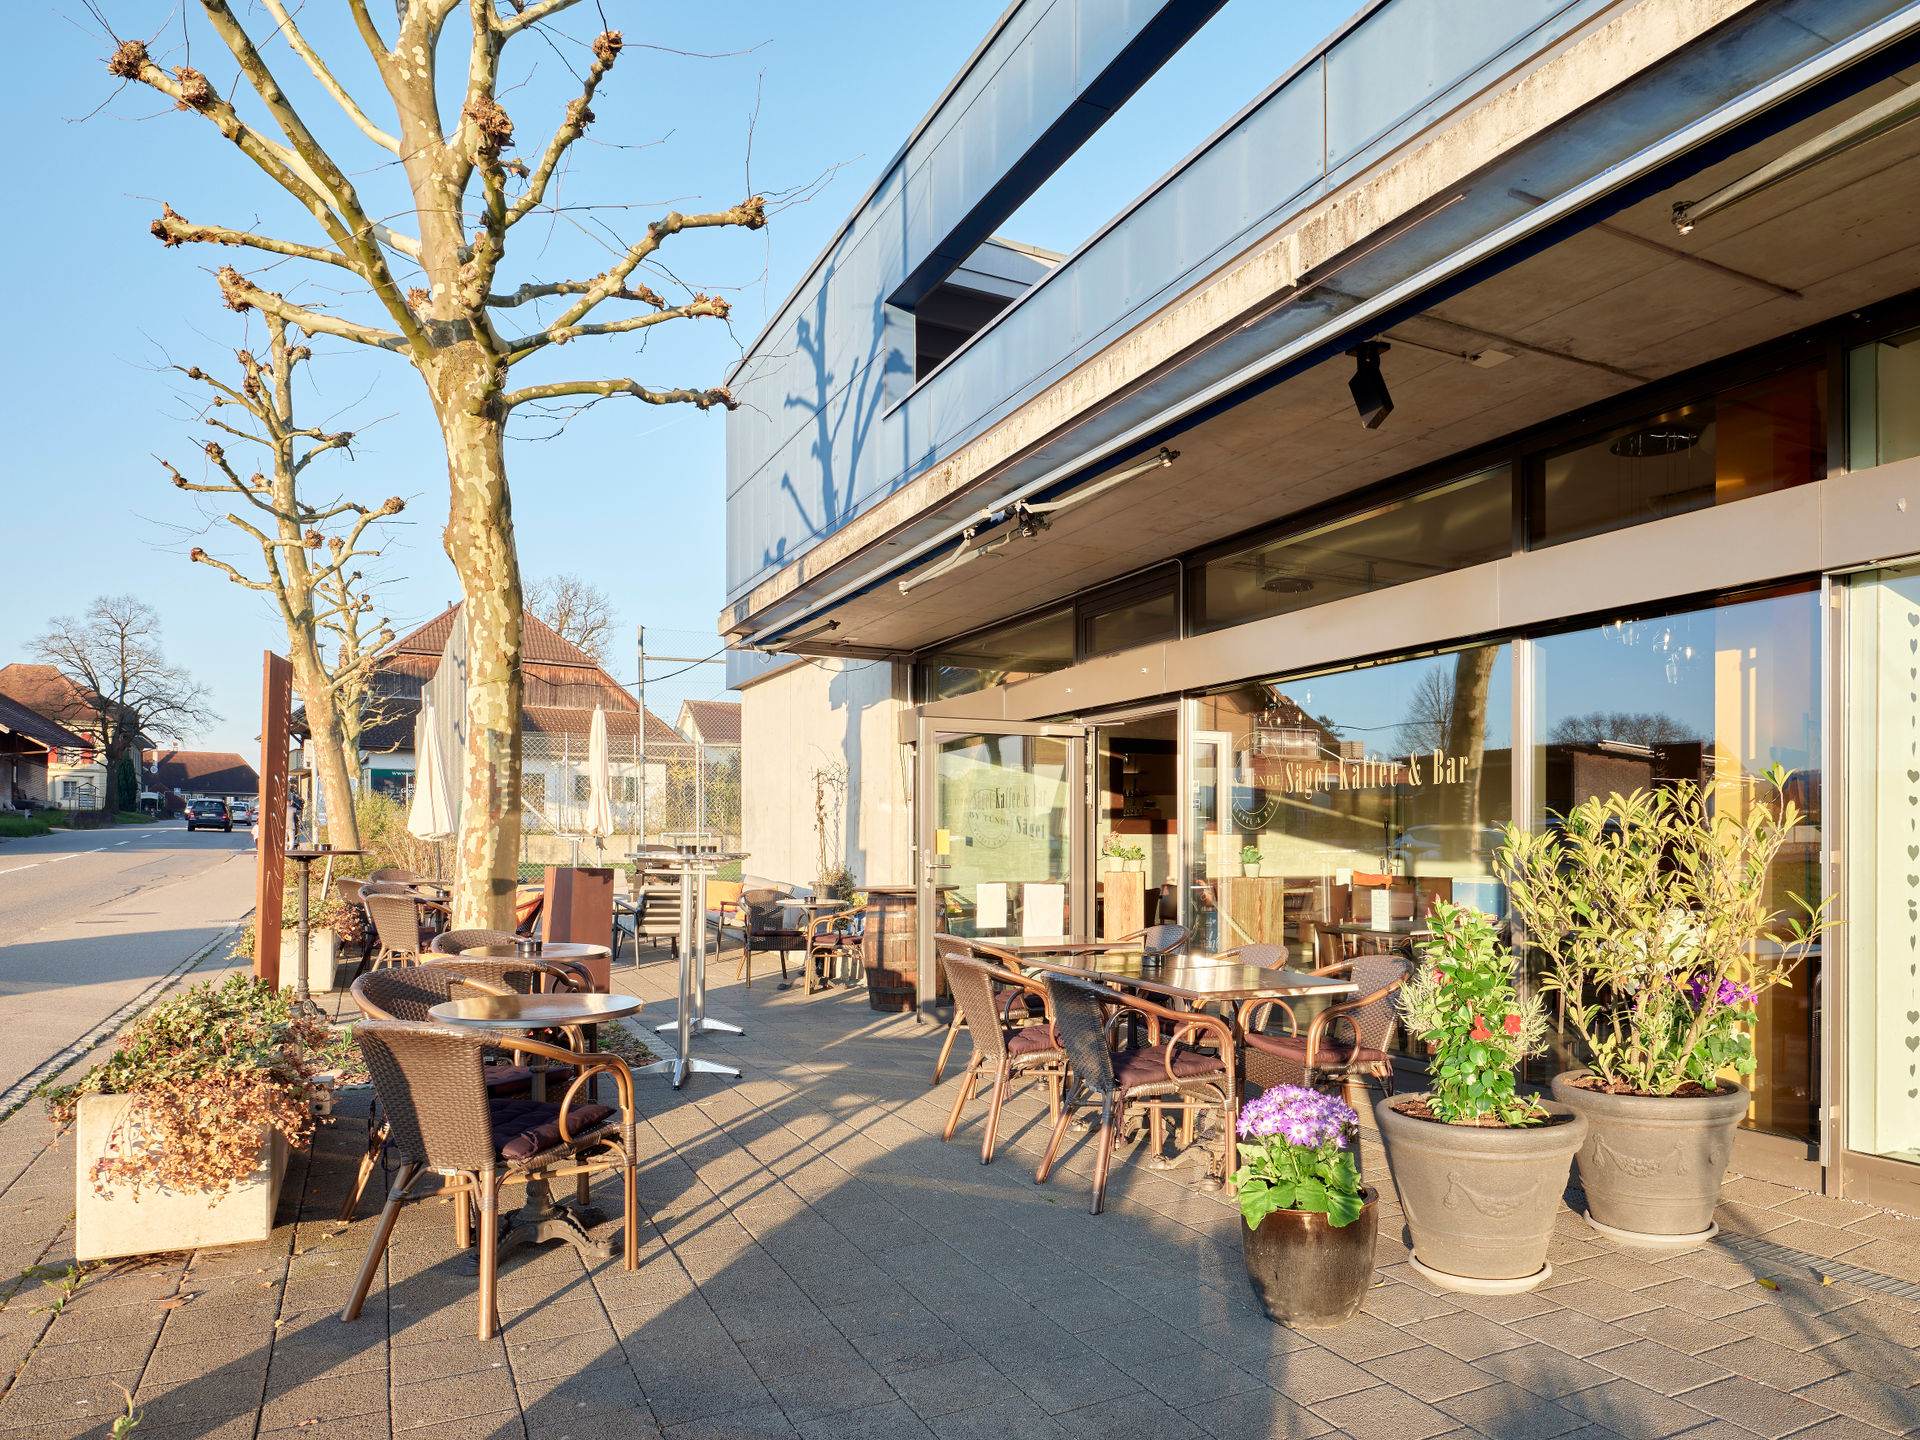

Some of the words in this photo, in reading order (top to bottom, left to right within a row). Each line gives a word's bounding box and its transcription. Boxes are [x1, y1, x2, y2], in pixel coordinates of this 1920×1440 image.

[1339, 754, 1399, 791] Kaffee
[1409, 750, 1422, 787] &
[1432, 748, 1469, 785] Bar
